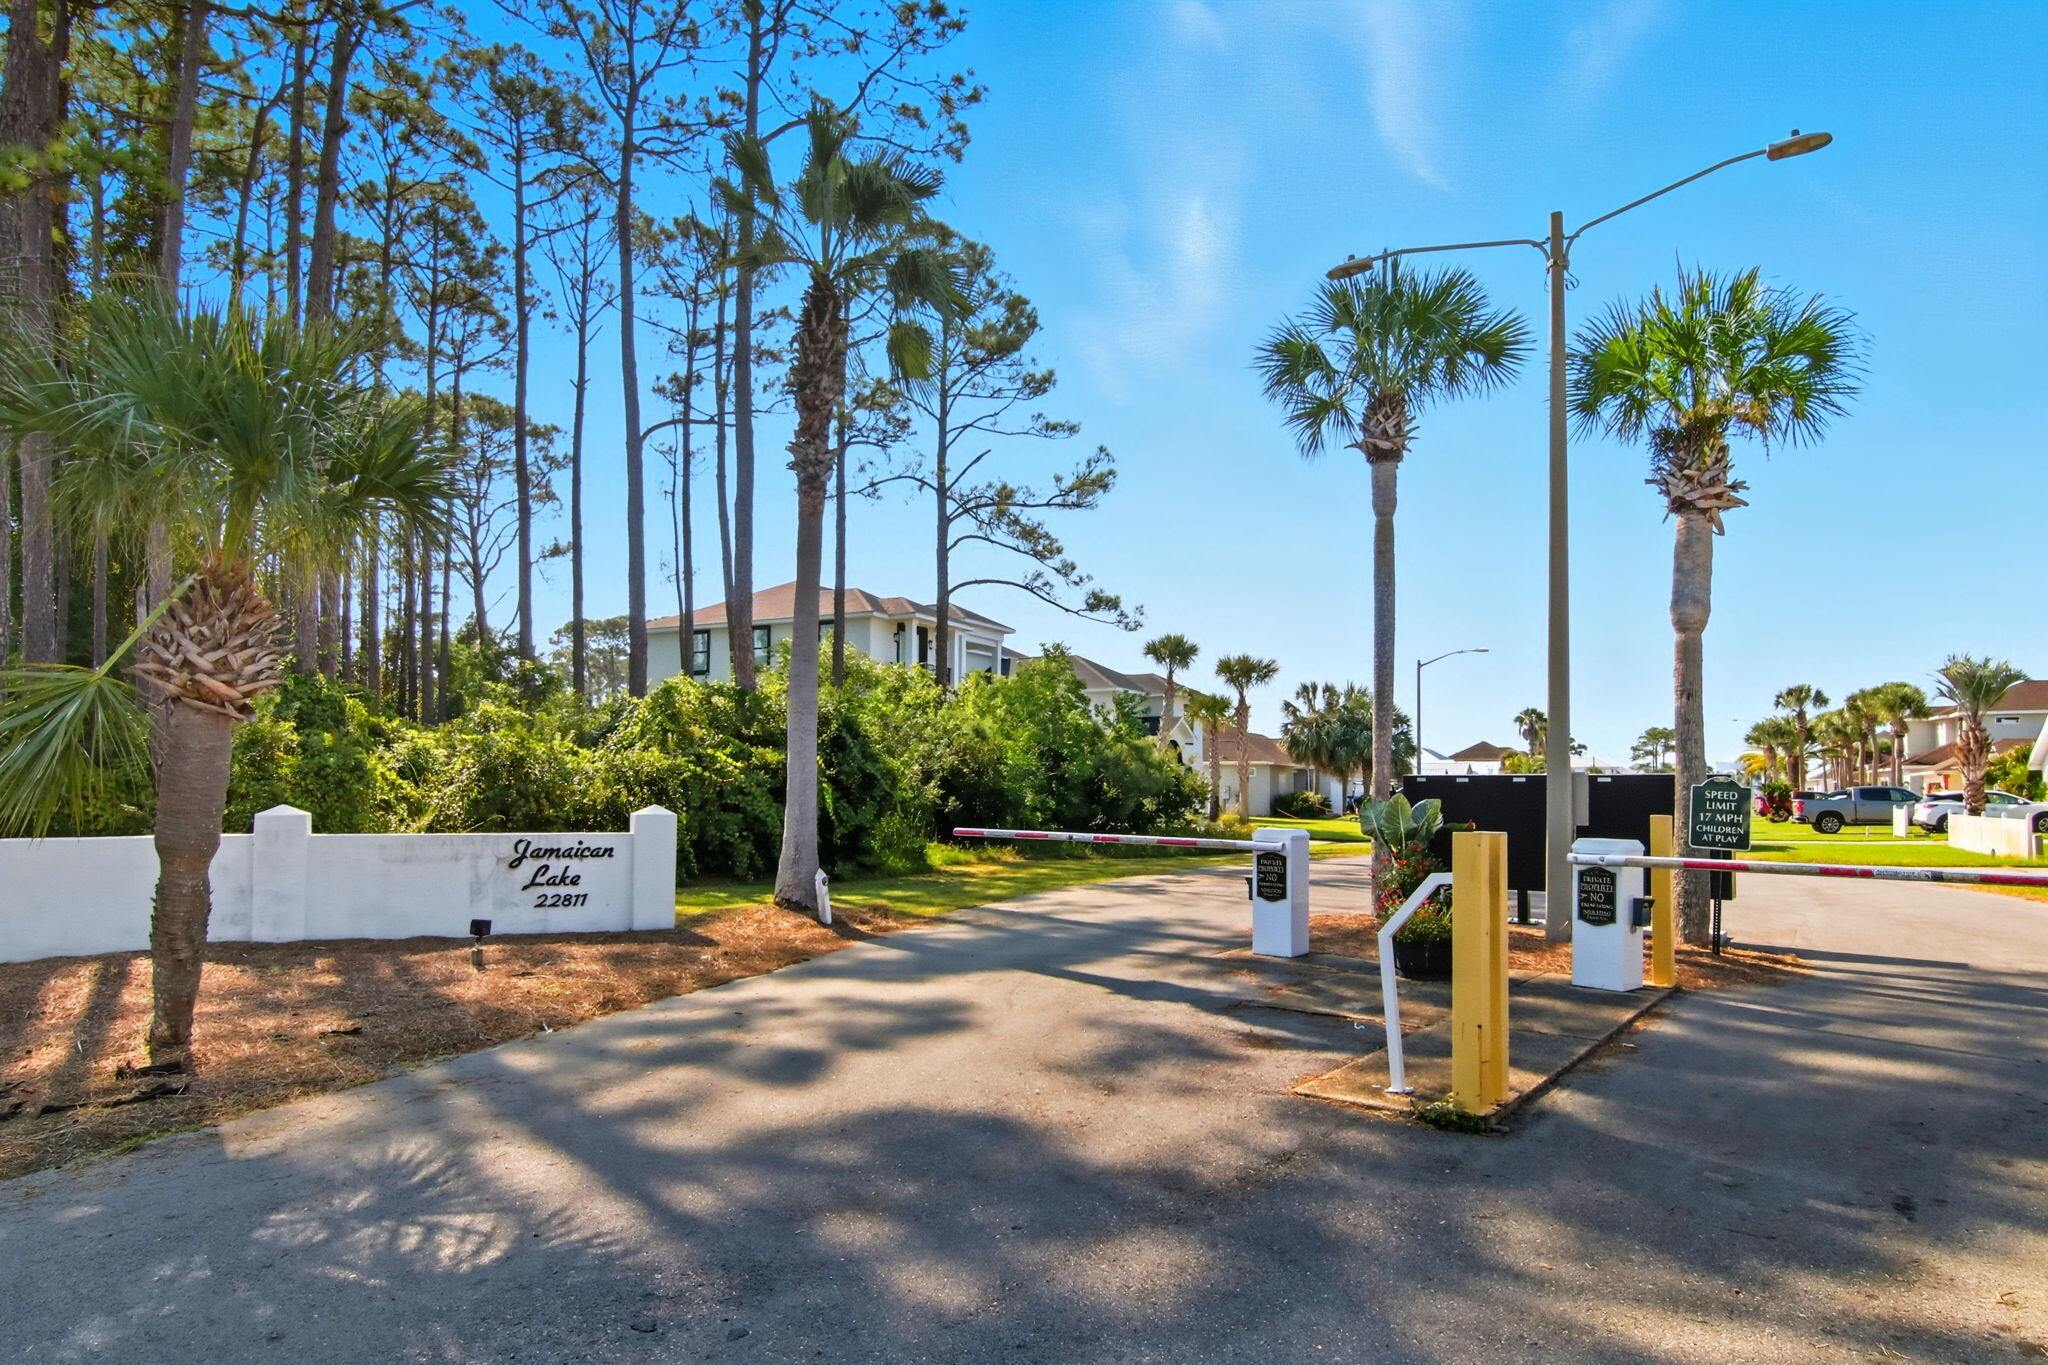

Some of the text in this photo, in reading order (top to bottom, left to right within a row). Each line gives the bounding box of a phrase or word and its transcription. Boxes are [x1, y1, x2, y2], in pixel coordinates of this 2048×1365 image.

[1704, 790, 1738, 800] SPEED
[1706, 801, 1737, 811] LIMIT
[1699, 812, 1743, 823] 17 MPH
[1696, 824, 1744, 835] CHILDREN
[1715, 834, 1739, 843] PLAY
[508, 839, 614, 869] Jamaican
[521, 864, 581, 891] Lake
[1266, 873, 1278, 881] NO
[533, 893, 588, 908] 22811
[1590, 893, 1605, 902] NO
